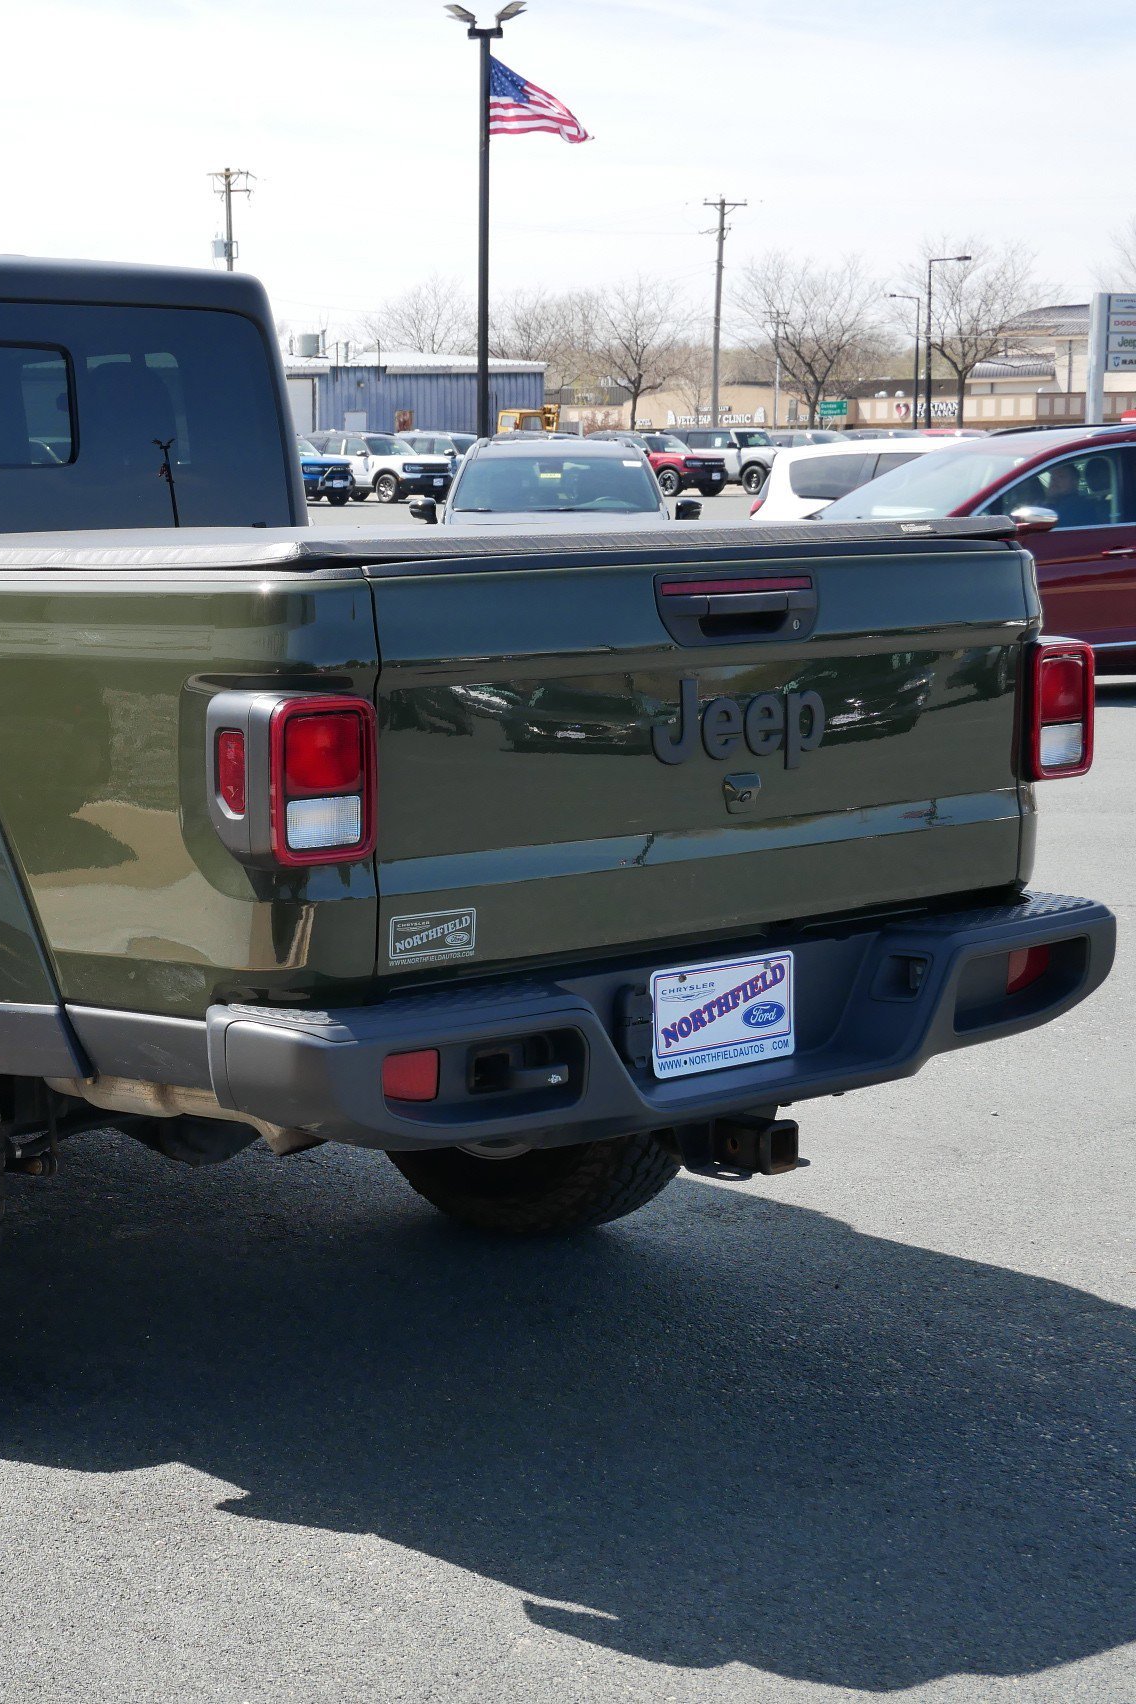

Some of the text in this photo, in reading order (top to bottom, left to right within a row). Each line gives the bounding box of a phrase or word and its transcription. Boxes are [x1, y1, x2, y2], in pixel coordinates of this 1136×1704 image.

[723, 414, 752, 424] CLINIC
[651, 679, 825, 769] Jeep
[395, 916, 471, 952] NORTHFIELD
[661, 981, 715, 996] CHRYSLER
[661, 962, 786, 1049] NORTHFIELD
[750, 1005, 777, 1024] Ford
